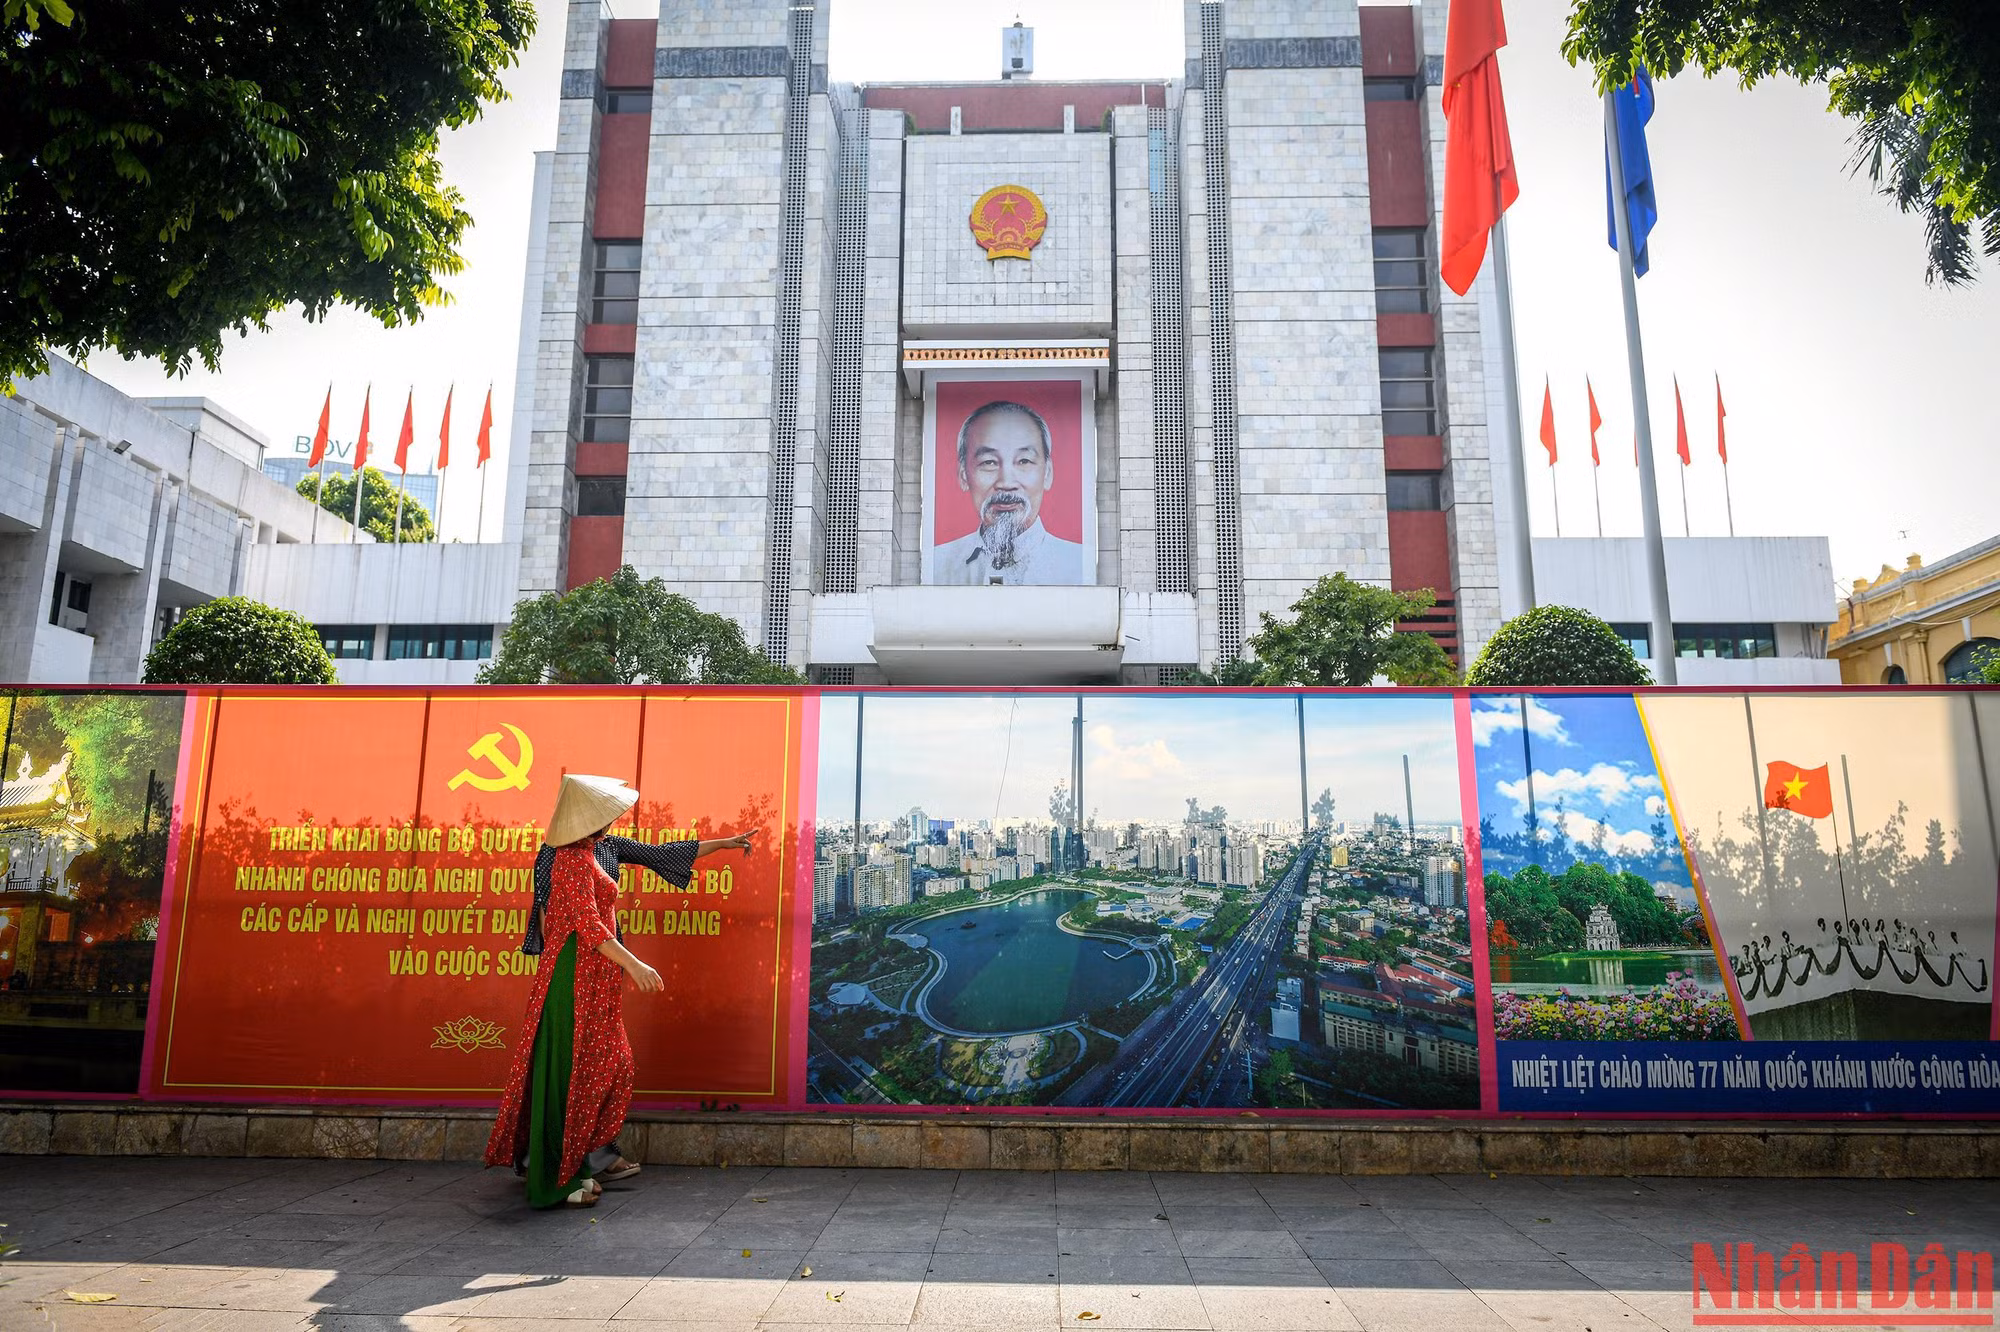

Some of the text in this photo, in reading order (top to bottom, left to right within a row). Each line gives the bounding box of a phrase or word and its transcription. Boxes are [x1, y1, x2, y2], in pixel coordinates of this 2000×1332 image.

[295, 435, 352, 458] BDV
[269, 818, 545, 857] TRIỂN KHAI ĐỒNG BỘ QUYẾT
[235, 863, 535, 898] NHANH CHÓNG ĐƯA NGHỊ QUY
[618, 863, 733, 899] ỘI ĐG BỘ
[240, 899, 526, 939] CÁC CẤP VÀ NGHỊ QUYẾT ĐẠI
[617, 898, 720, 935] CỦA ĐẢNG
[389, 942, 540, 981] VÀO CUỘC SỐN
[1512, 1050, 2000, 1095] NHIỆT LIỆT CHÀO MỪNG 77 NĂM QUỐC KHÁNH NƯỚC CỘNG HÒA
